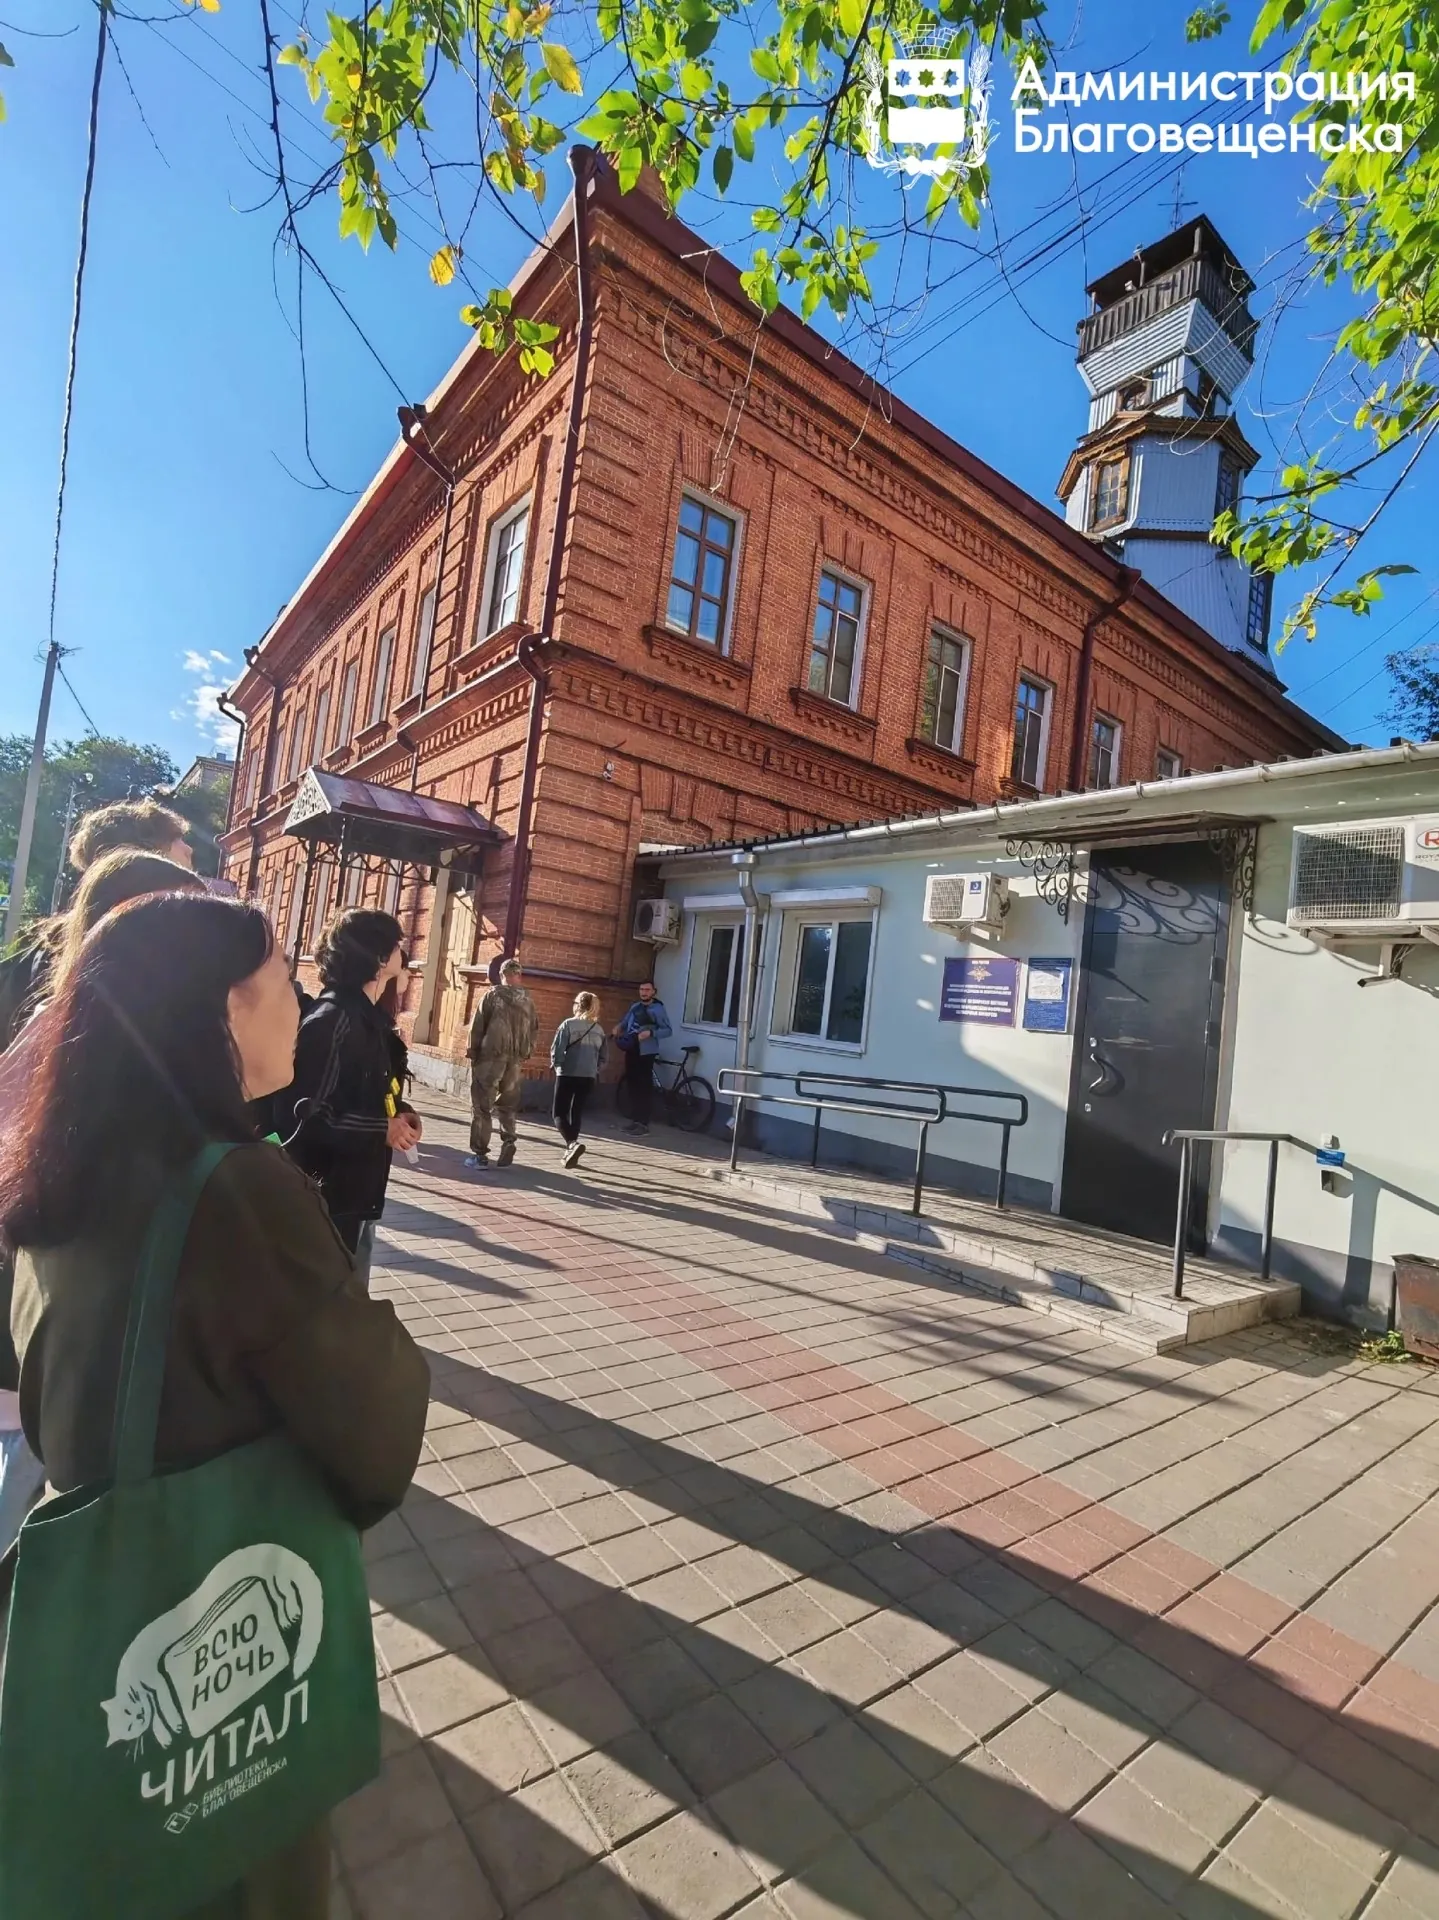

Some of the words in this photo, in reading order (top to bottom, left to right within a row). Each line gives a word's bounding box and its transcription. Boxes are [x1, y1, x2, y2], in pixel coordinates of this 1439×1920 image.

[193, 1613, 258, 1676] ВСЮ
[191, 1644, 275, 1711] НОЧЬ
[140, 1680, 309, 1806] ЧИТАЛ
[202, 1756, 288, 1818] БЛАГОВЕЩЕНСКА
[203, 1756, 268, 1804] БИБЛИОТЕКИ
